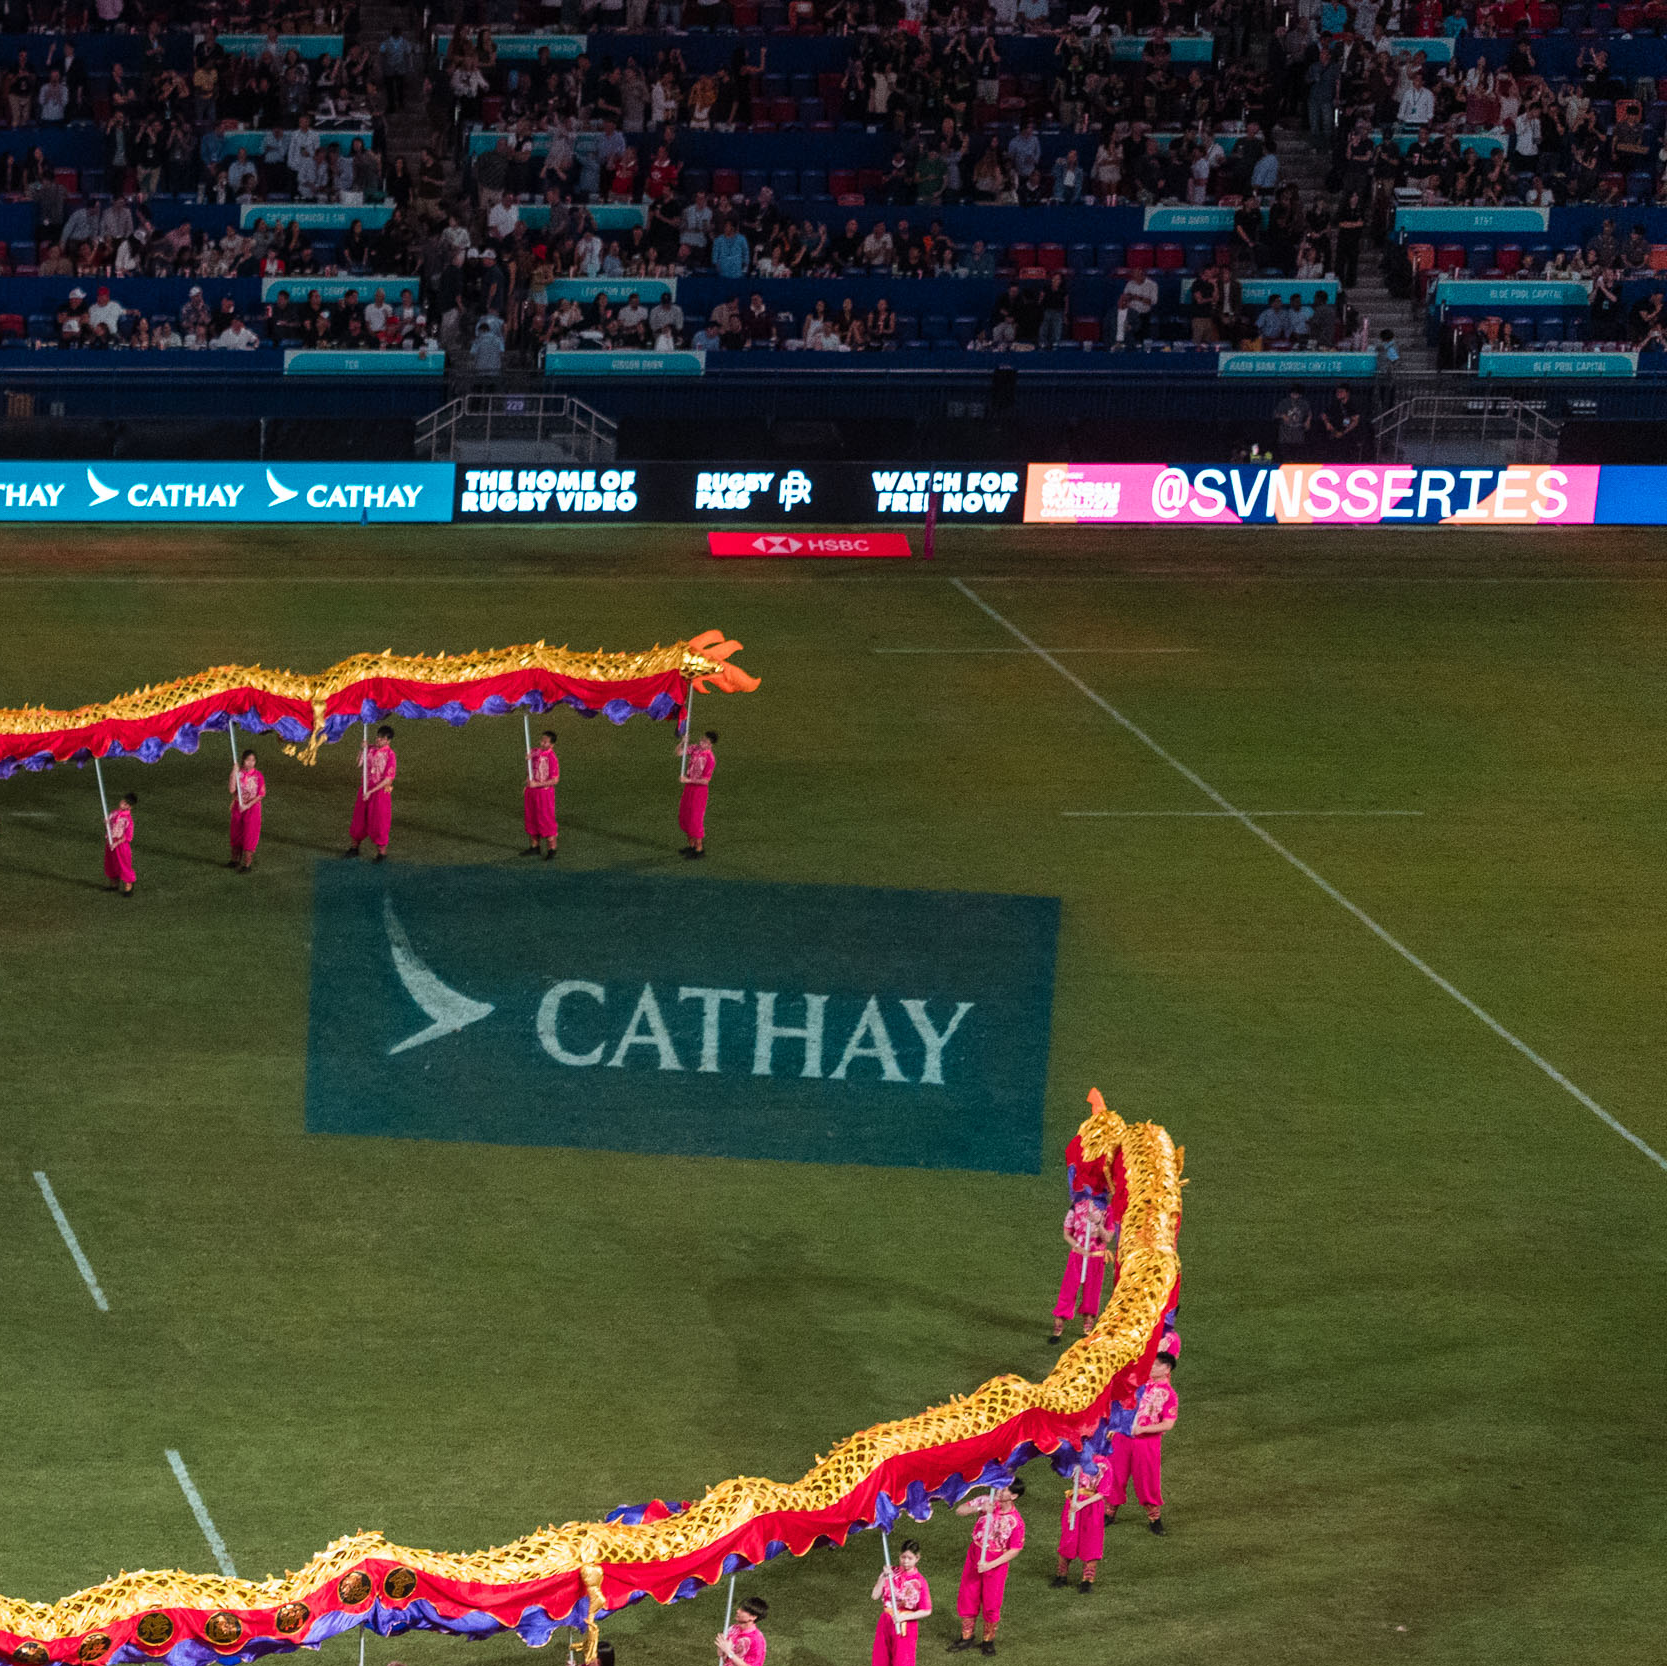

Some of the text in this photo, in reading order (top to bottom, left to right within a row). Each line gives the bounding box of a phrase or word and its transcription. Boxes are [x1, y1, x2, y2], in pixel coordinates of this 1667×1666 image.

[465, 471, 636, 491] THE HOME OF
[697, 473, 774, 493] RUGBY
[967, 472, 1018, 492] FOR
[127, 484, 244, 508] CATHAY
[306, 485, 423, 508] CATHAY
[461, 491, 637, 512] RUGBY VIDEO
[695, 490, 751, 509] PASS
[943, 492, 1010, 512] NOW
[1151, 468, 1568, 519] @SVNSSERIES
[806, 539, 870, 552] HSBC
[536, 978, 975, 1085] CATHAY
